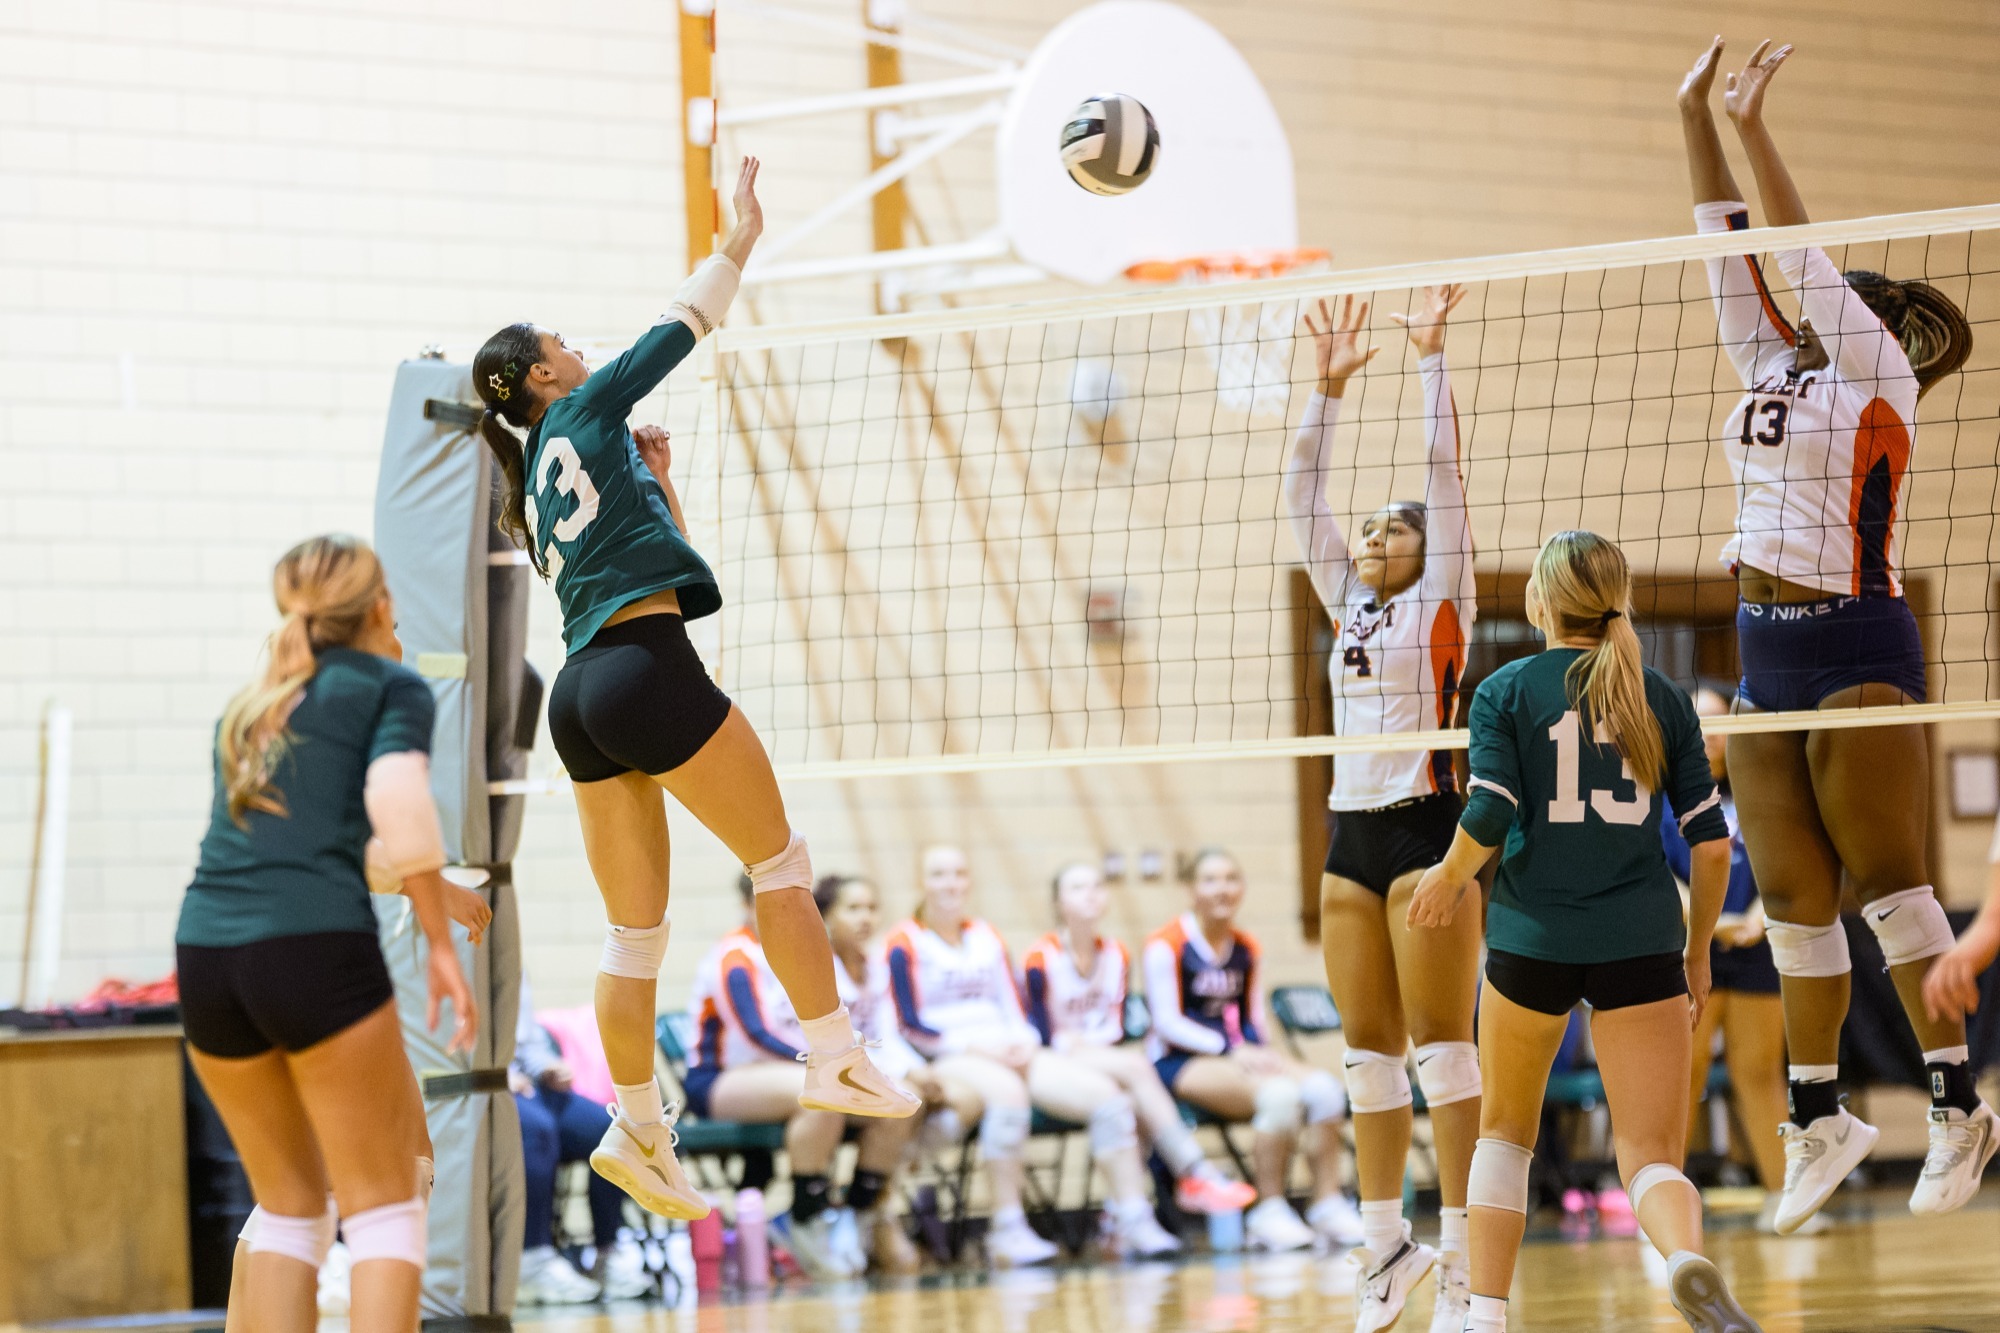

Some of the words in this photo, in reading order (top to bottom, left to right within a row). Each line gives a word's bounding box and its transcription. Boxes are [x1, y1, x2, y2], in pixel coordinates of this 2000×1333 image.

[1740, 399, 1789, 448] 13
[1771, 602, 1832, 621] NIKE
[1343, 645, 1372, 677] 4
[1548, 710, 1652, 826] 13
